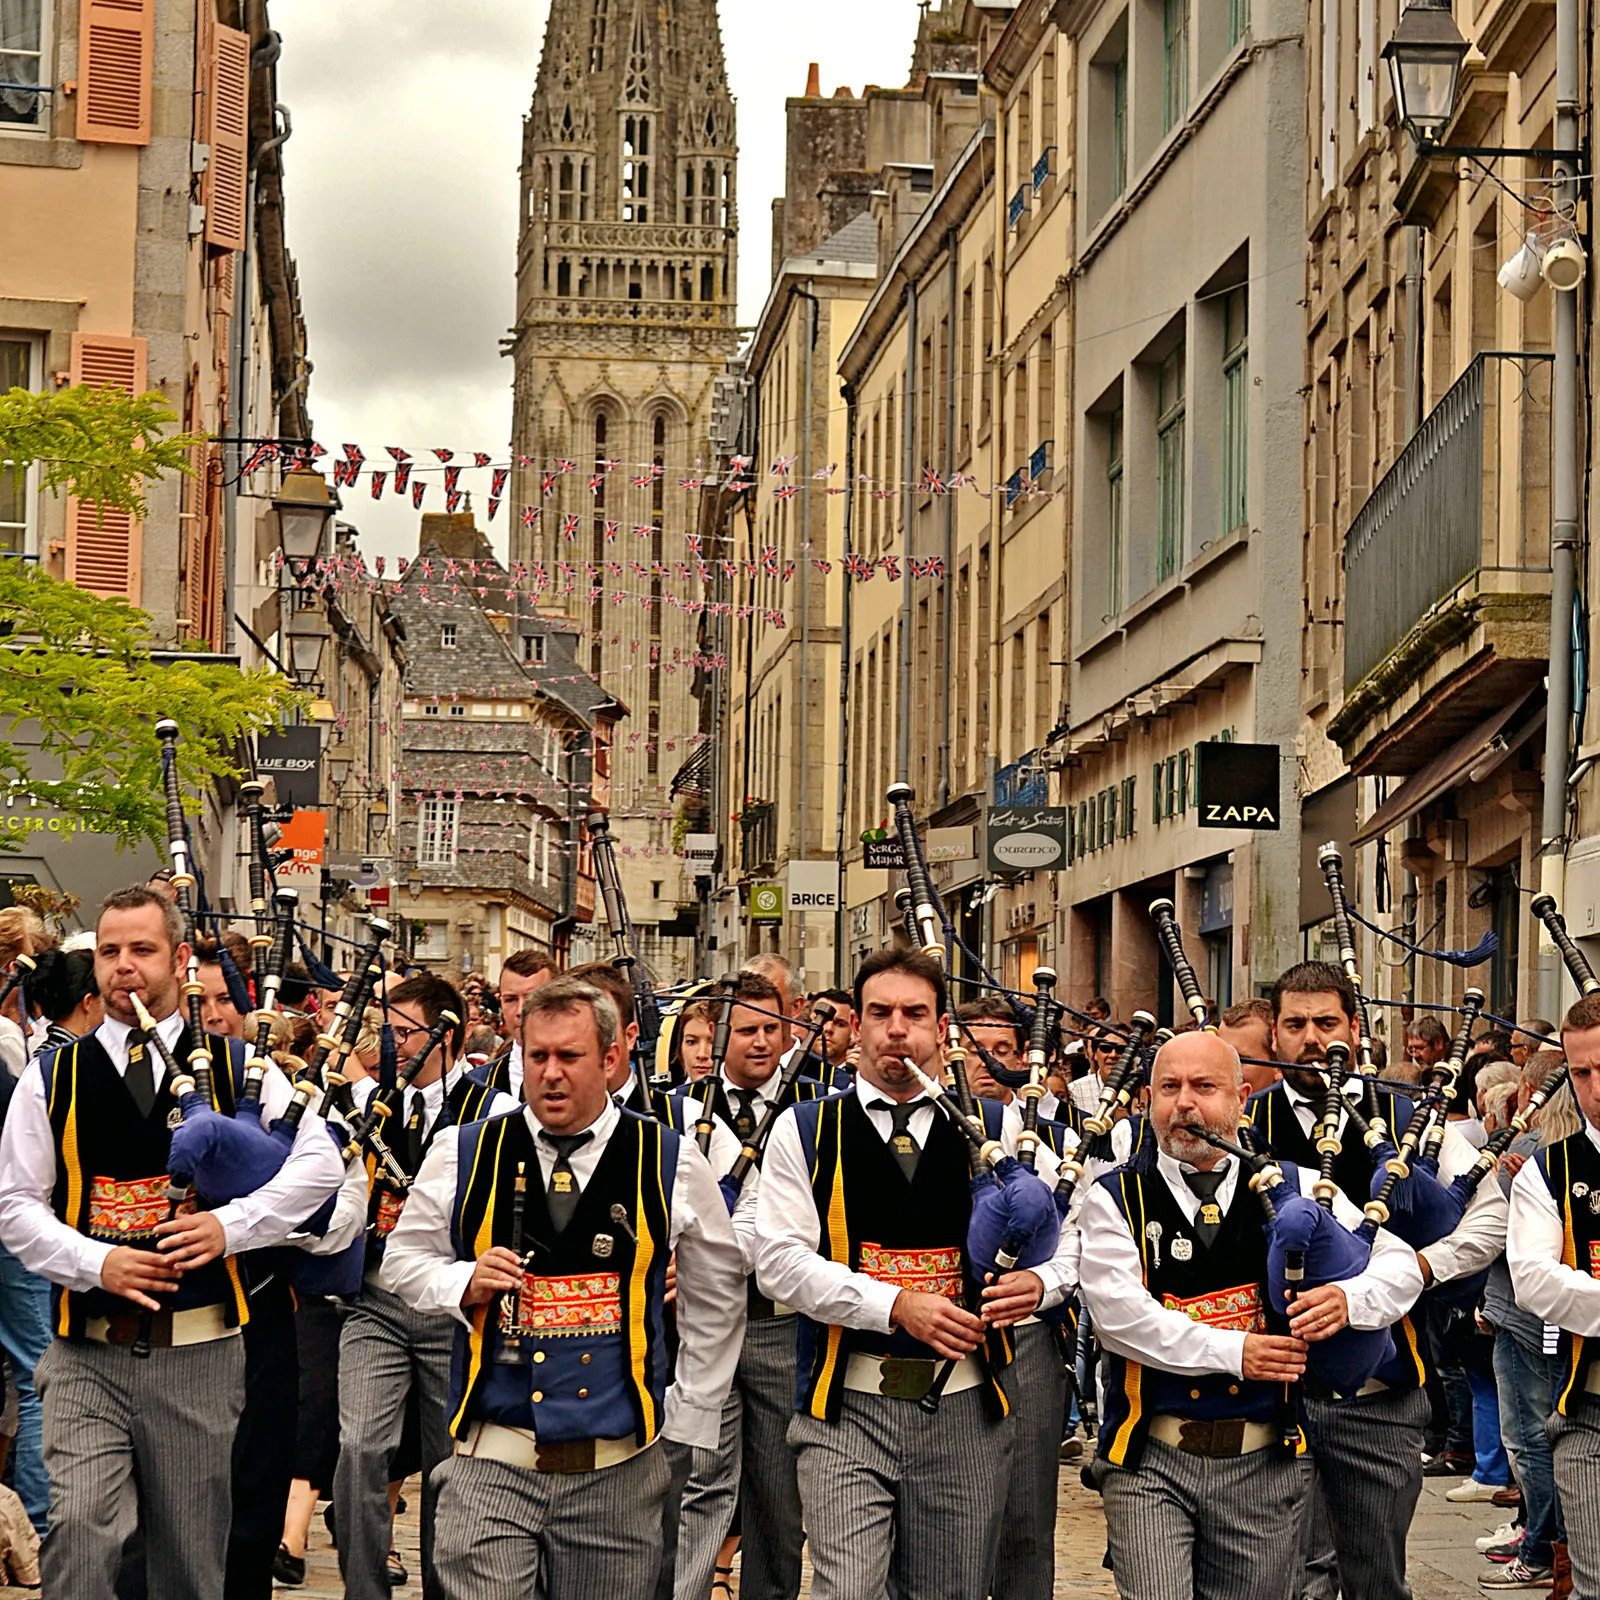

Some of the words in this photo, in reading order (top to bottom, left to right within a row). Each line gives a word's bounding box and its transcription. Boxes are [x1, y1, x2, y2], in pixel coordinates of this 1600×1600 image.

[256, 757, 283, 769] LUE
[286, 758, 316, 771] BOX
[1206, 804, 1275, 823] ZAPA
[791, 893, 836, 906] BRICE
